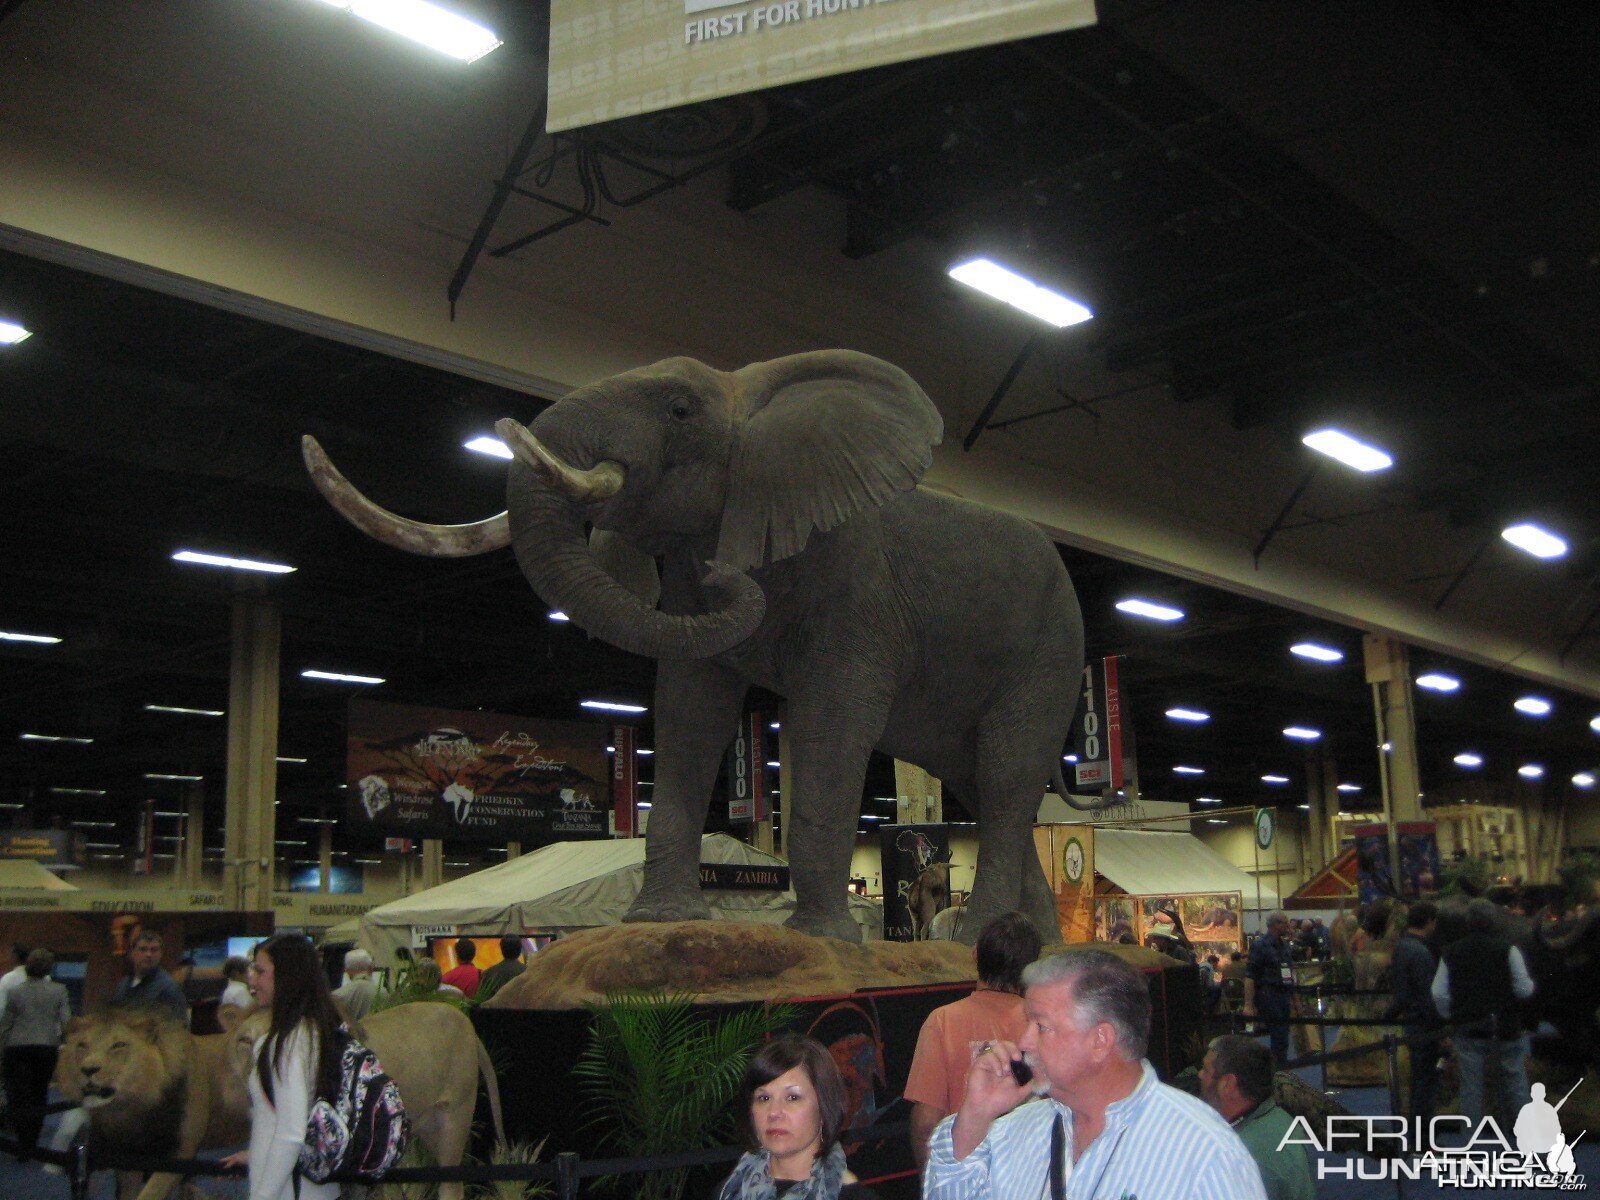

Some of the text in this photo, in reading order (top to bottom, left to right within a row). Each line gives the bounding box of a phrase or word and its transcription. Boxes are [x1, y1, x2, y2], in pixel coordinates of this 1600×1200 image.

[684, 11, 748, 44] FIRST
[753, 0, 800, 30] FOR
[1107, 688, 1120, 731] AISLE
[469, 806, 545, 818] CONSERVATION
[467, 816, 497, 826] FUND
[735, 870, 778, 884] ZAMBIA
